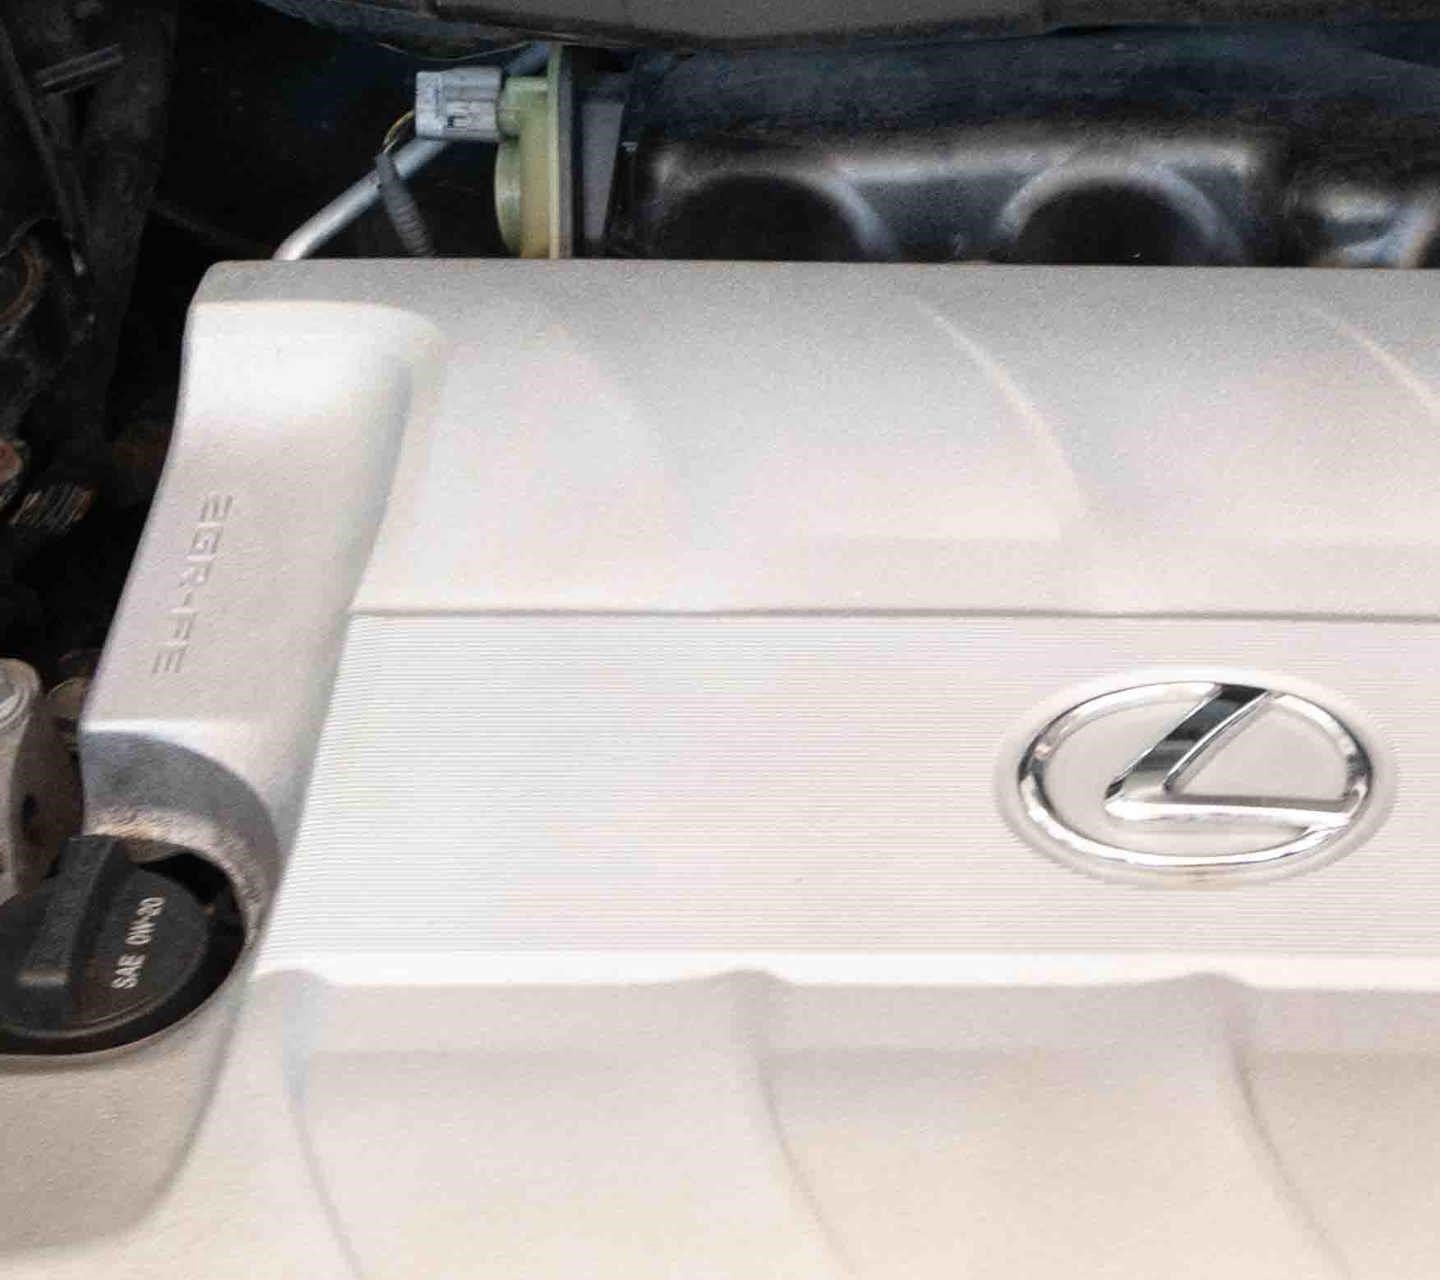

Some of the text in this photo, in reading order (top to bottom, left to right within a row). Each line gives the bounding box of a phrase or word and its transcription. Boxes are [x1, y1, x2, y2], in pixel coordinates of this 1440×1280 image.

[151, 494, 234, 674] 2GR-FE
[111, 897, 166, 989] SAE 0W-20
